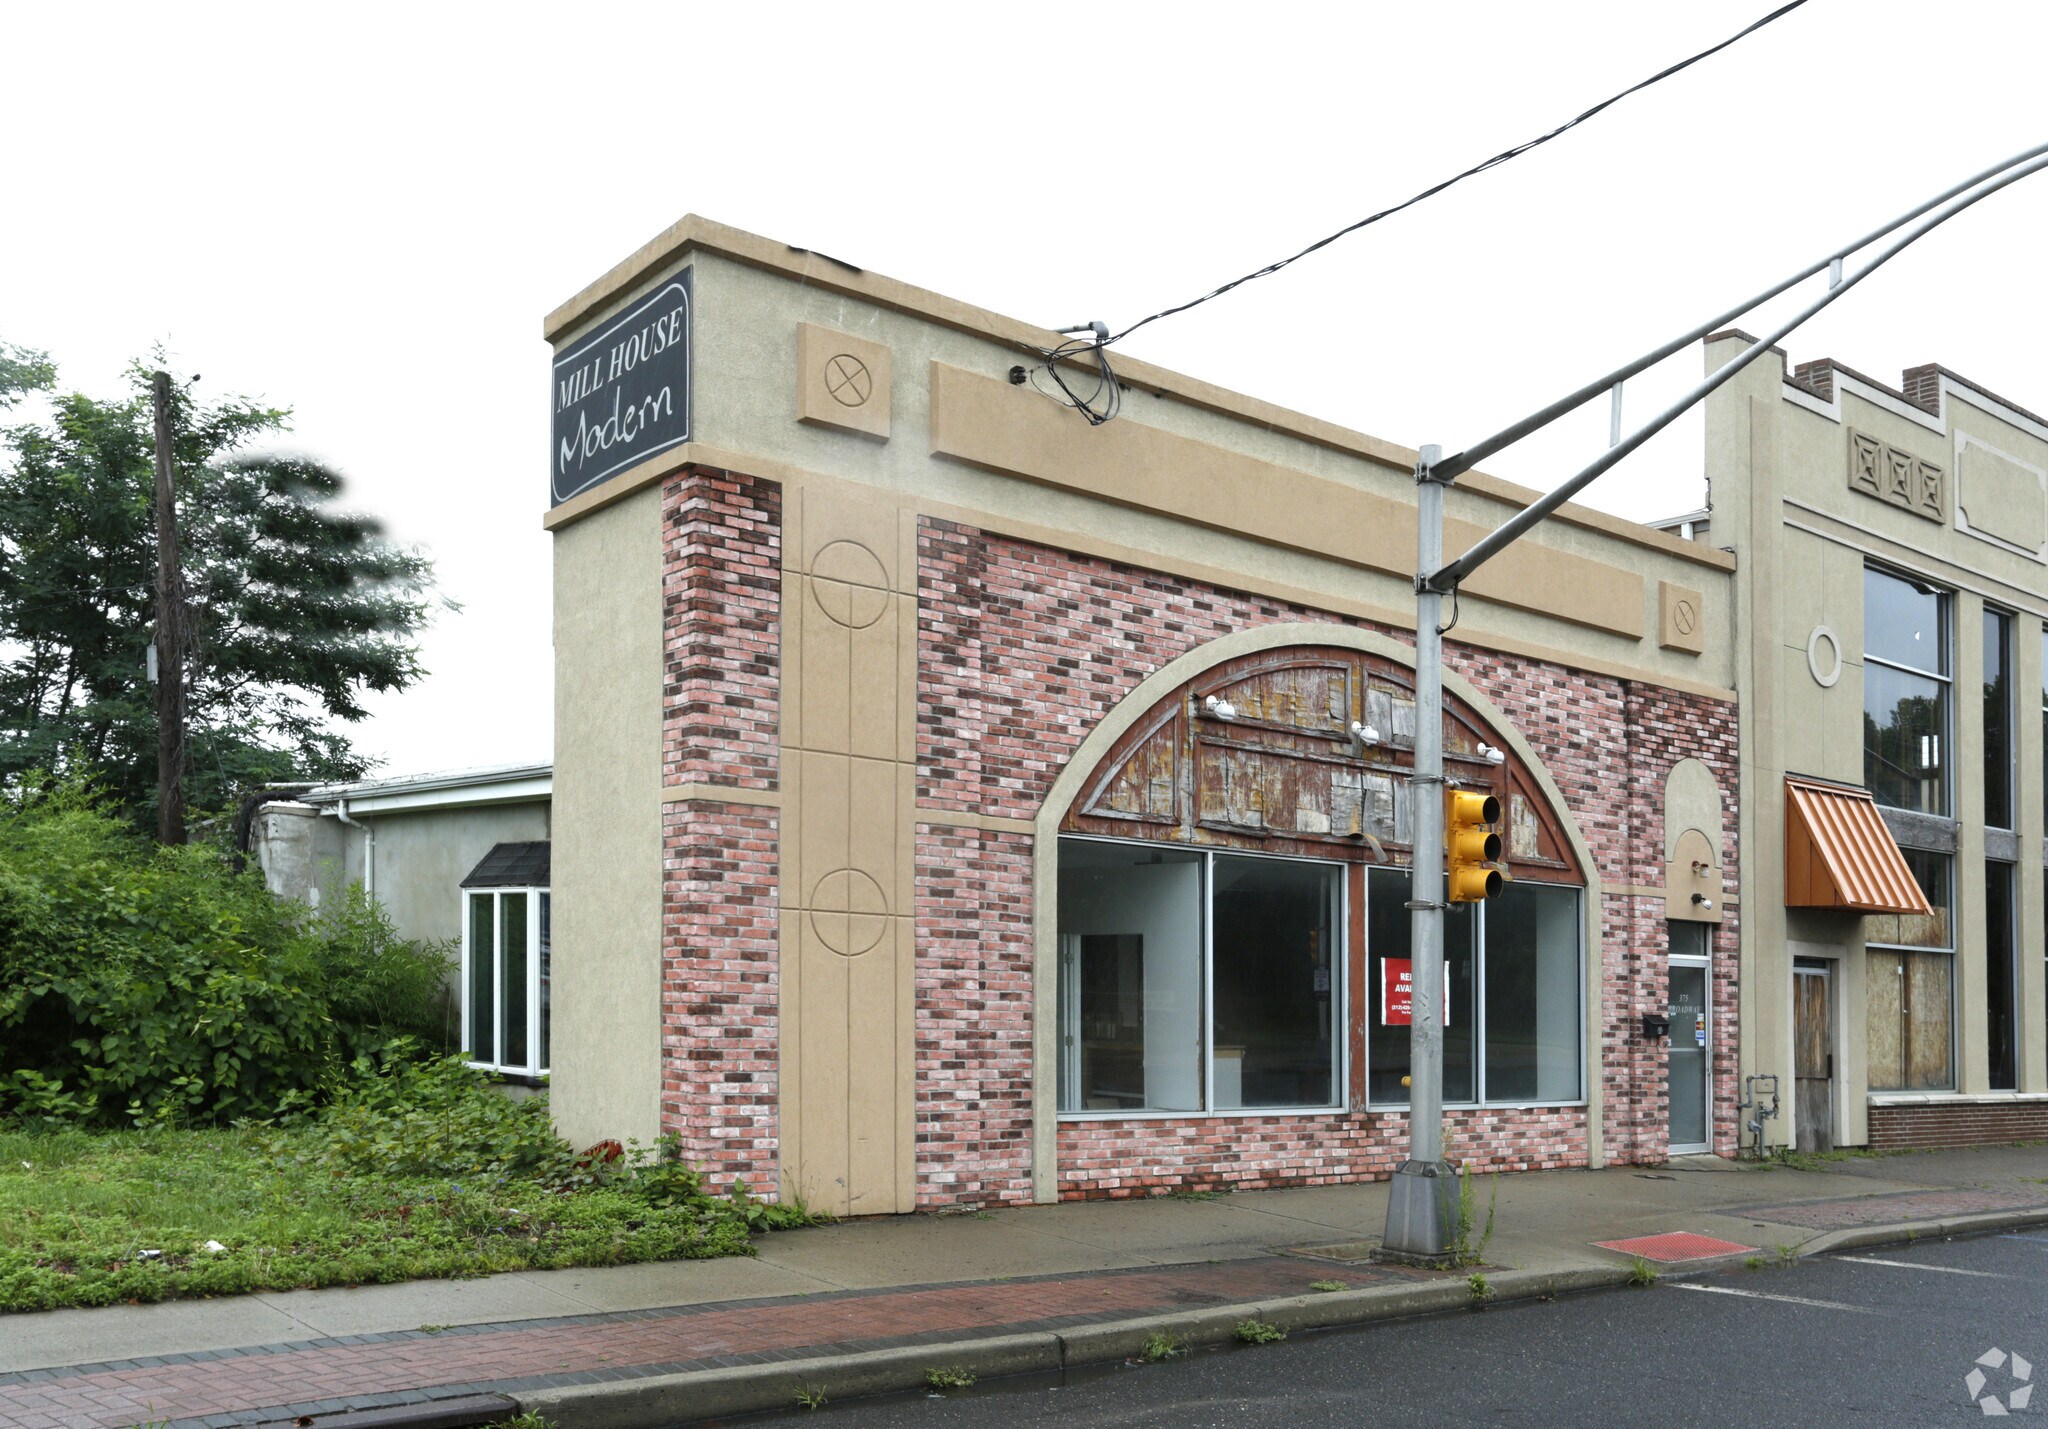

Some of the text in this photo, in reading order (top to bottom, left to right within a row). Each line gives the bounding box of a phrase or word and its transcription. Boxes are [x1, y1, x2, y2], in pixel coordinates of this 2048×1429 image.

[557, 306, 683, 414] MILL HOUSE
[560, 385, 673, 474] Modern
